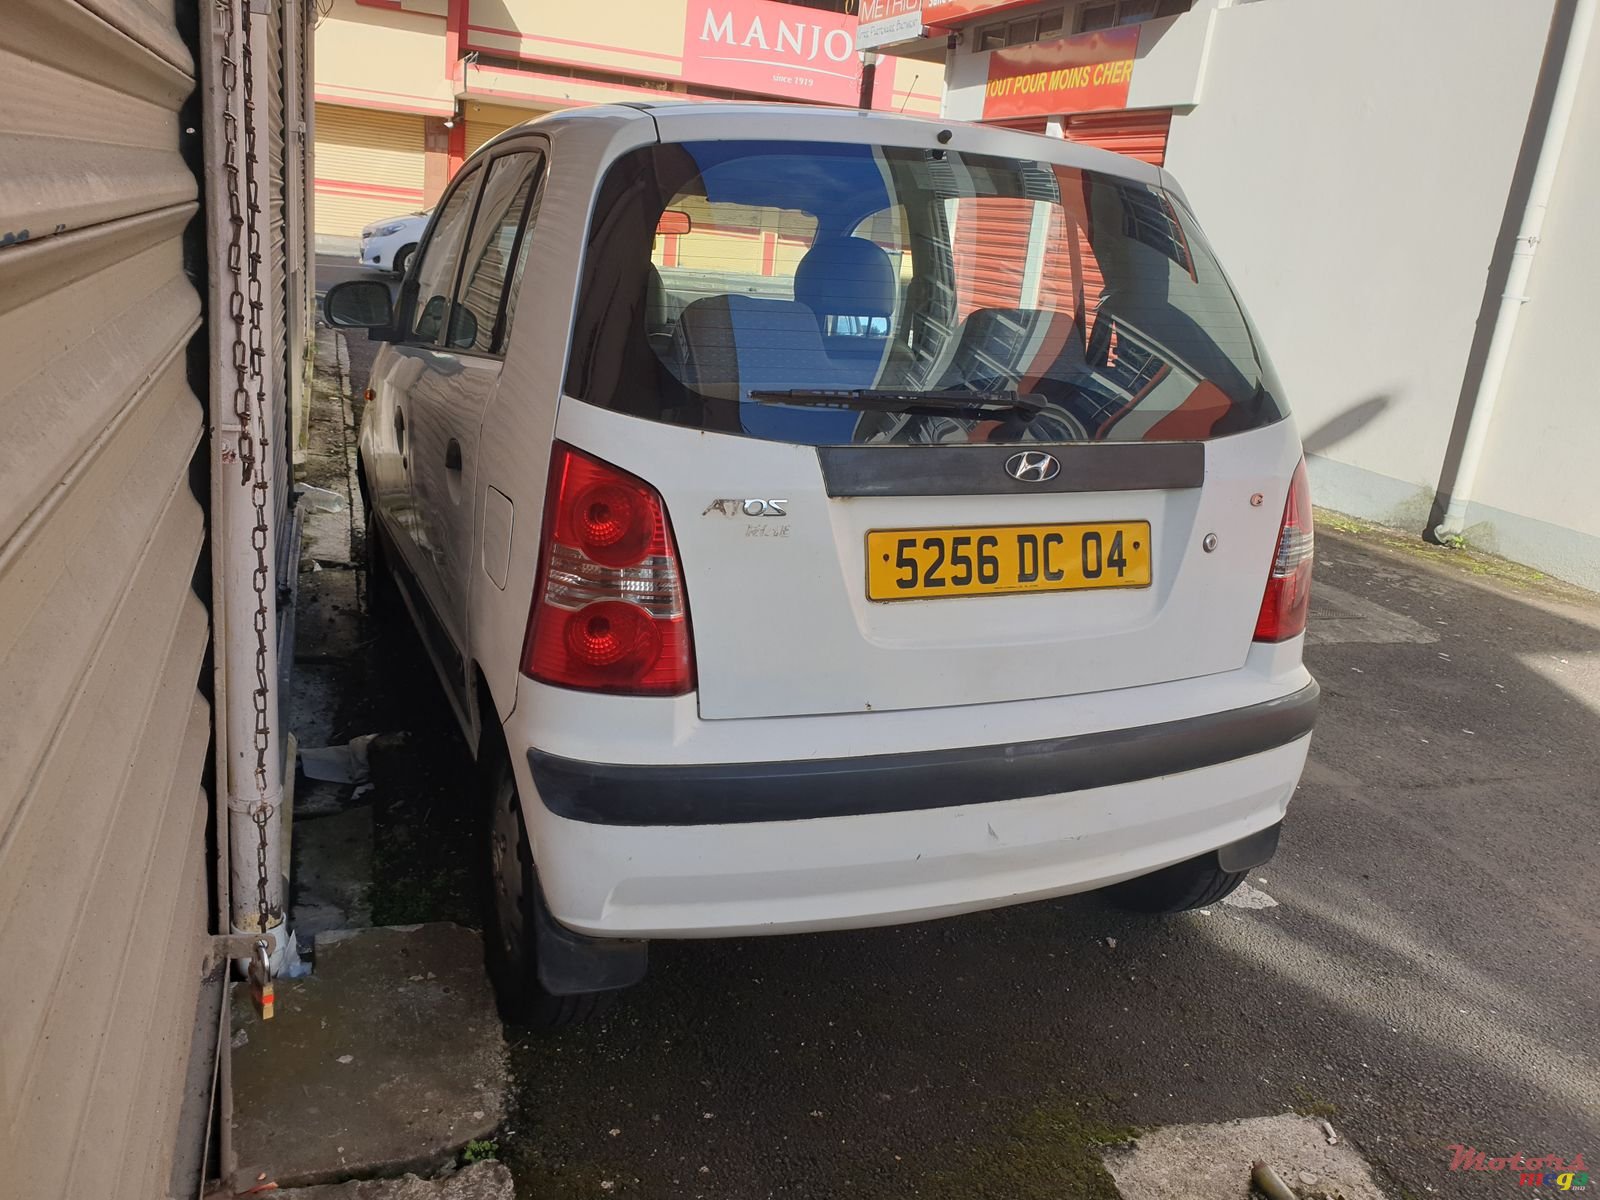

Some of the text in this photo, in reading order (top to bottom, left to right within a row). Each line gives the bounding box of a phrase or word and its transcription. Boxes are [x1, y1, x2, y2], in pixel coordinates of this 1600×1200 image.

[772, 73, 814, 87] since 1919
[1013, 72, 1047, 95] POUR
[1048, 66, 1091, 91] MOINS
[1093, 60, 1134, 86] CHER
[896, 530, 1127, 589] 5256 DC 04
